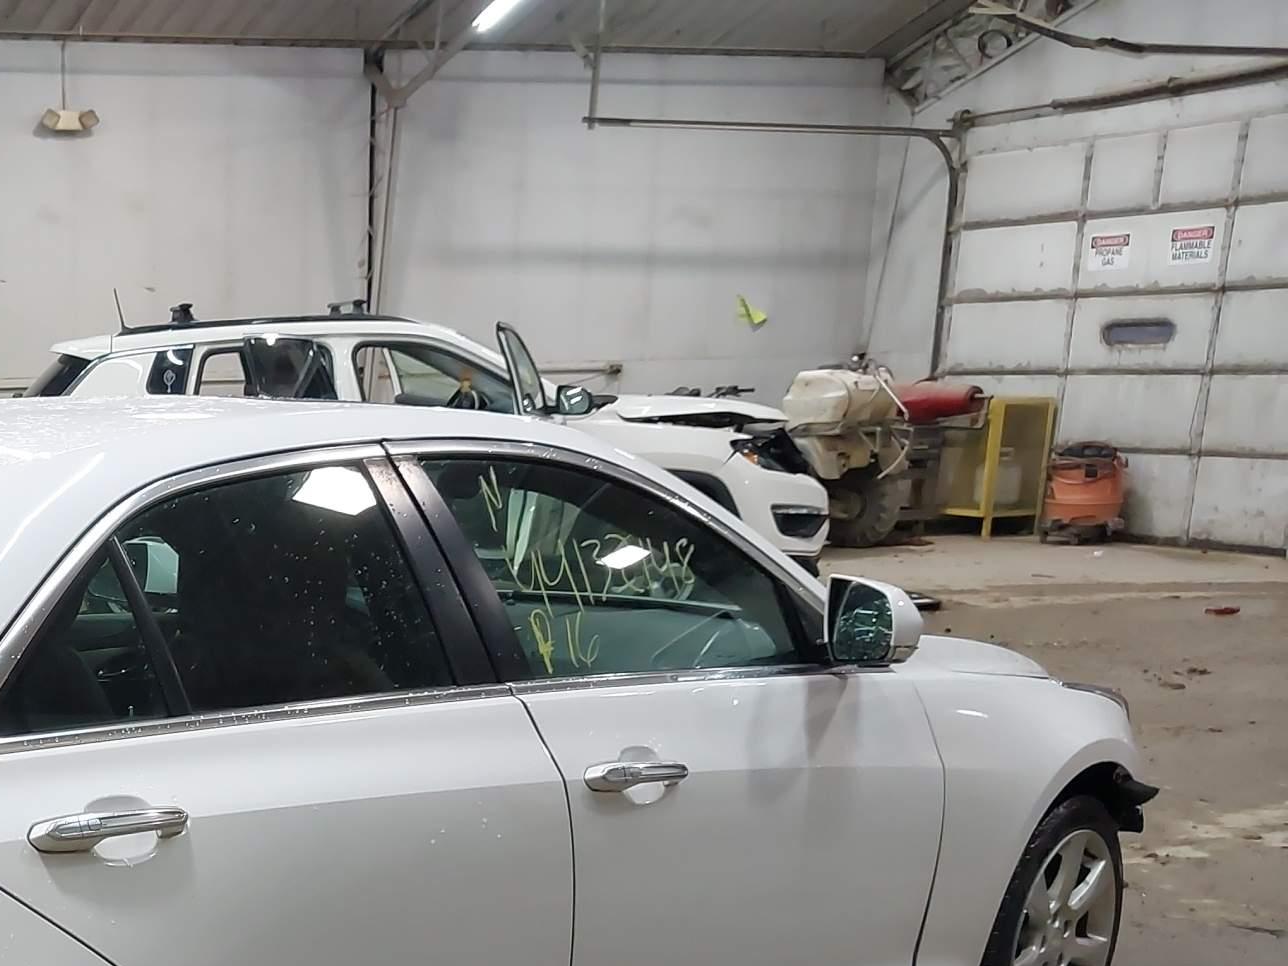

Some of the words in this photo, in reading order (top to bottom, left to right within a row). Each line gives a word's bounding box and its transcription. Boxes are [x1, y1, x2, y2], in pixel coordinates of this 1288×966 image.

[1177, 229, 1208, 240] DANGER
[1171, 240, 1211, 251] FLAMMABLE
[1095, 247, 1123, 256] PROPANE
[1171, 250, 1208, 261] MATERIALS
[1102, 257, 1114, 266] GAS
